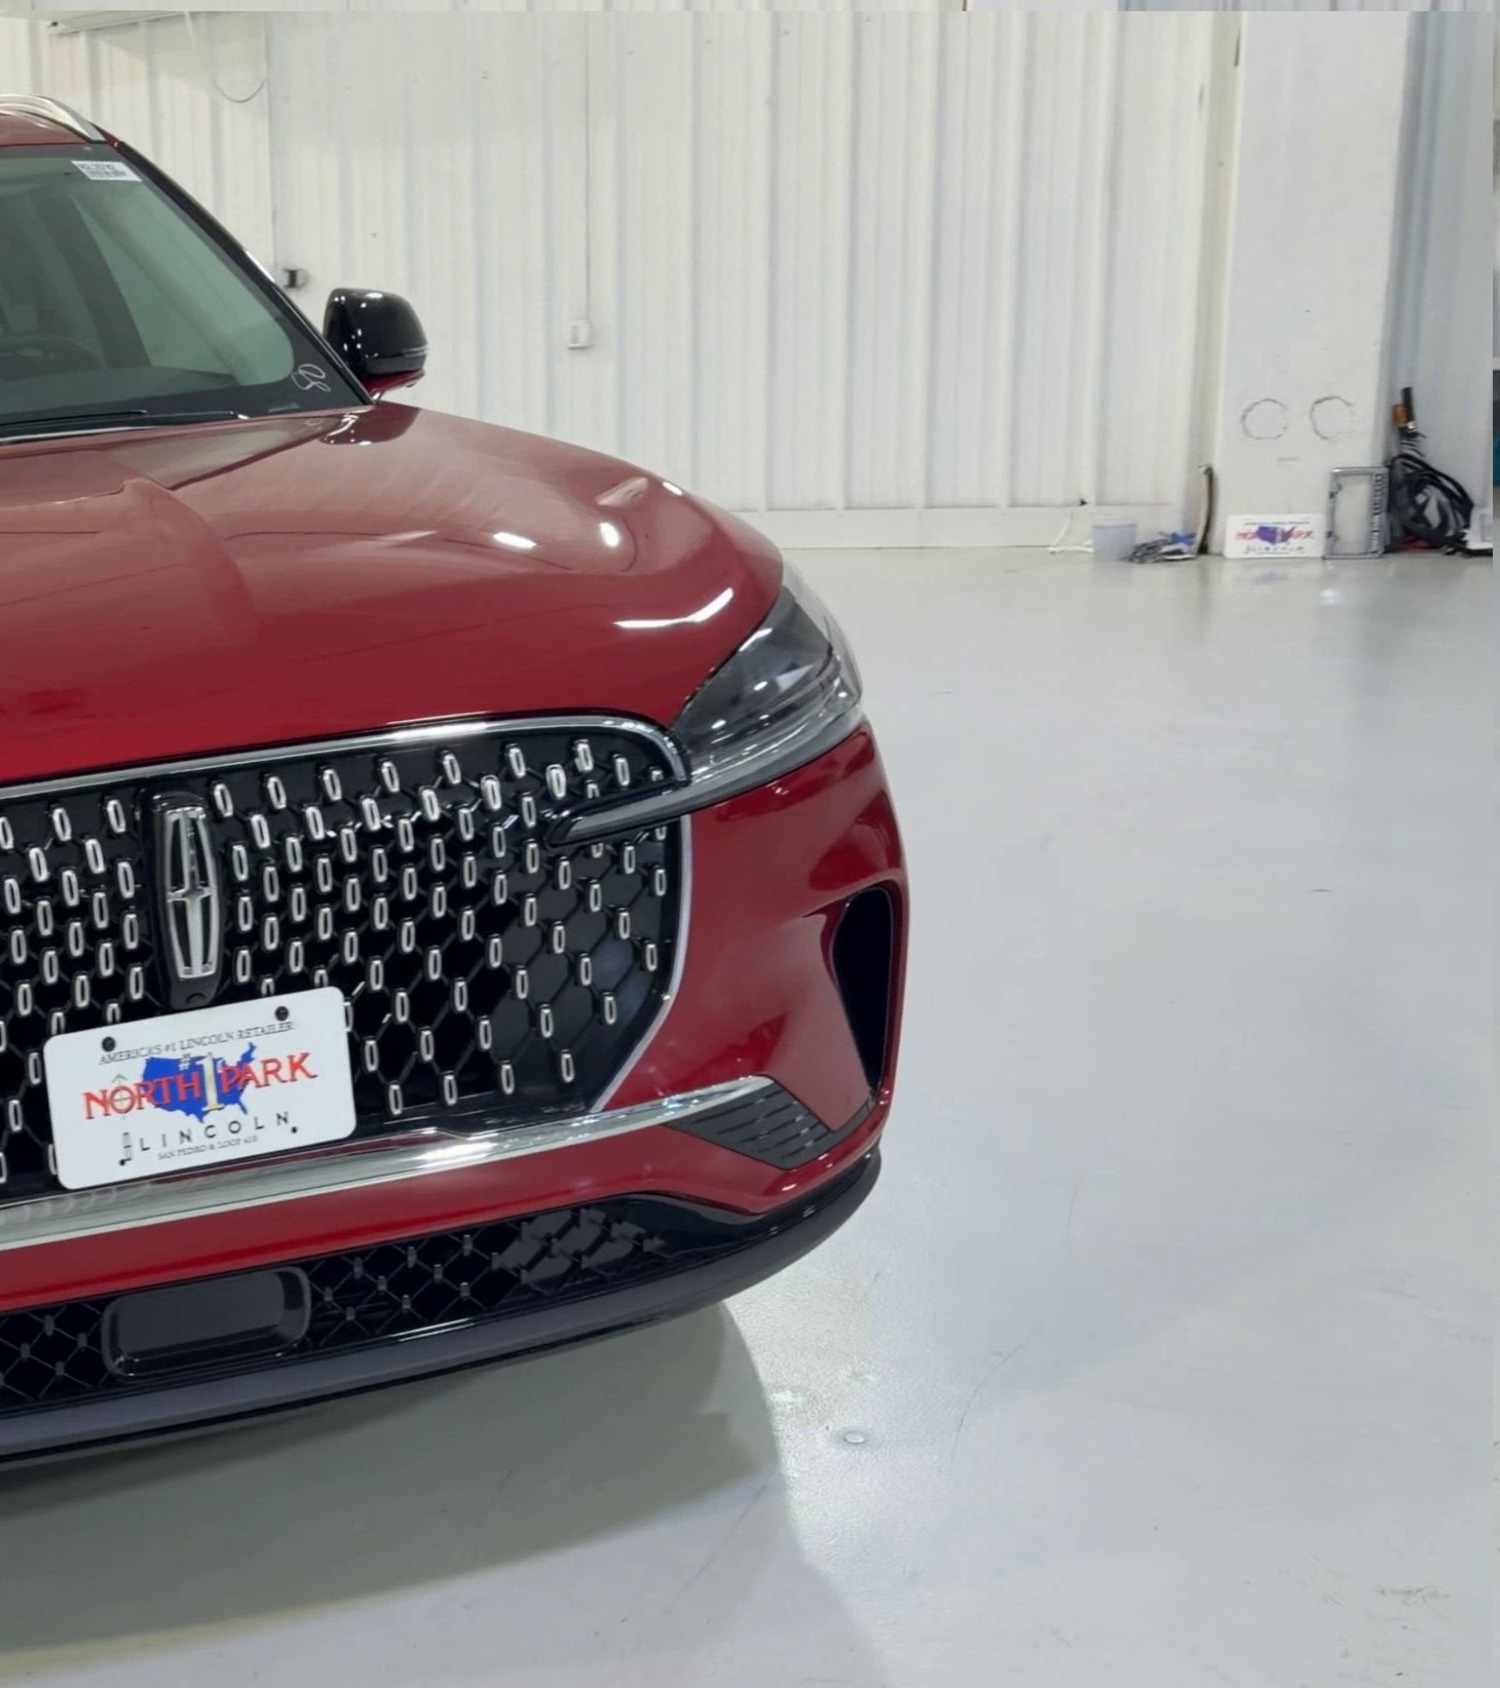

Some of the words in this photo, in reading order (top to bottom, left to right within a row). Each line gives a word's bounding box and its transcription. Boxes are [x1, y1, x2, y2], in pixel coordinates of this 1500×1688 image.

[180, 1031, 234, 1050] LINCOLN
[238, 1021, 295, 1040] RETAILER
[82, 1071, 202, 1119] NORTH
[219, 1052, 318, 1094] PARK
[139, 1111, 289, 1151] LINCOLN
